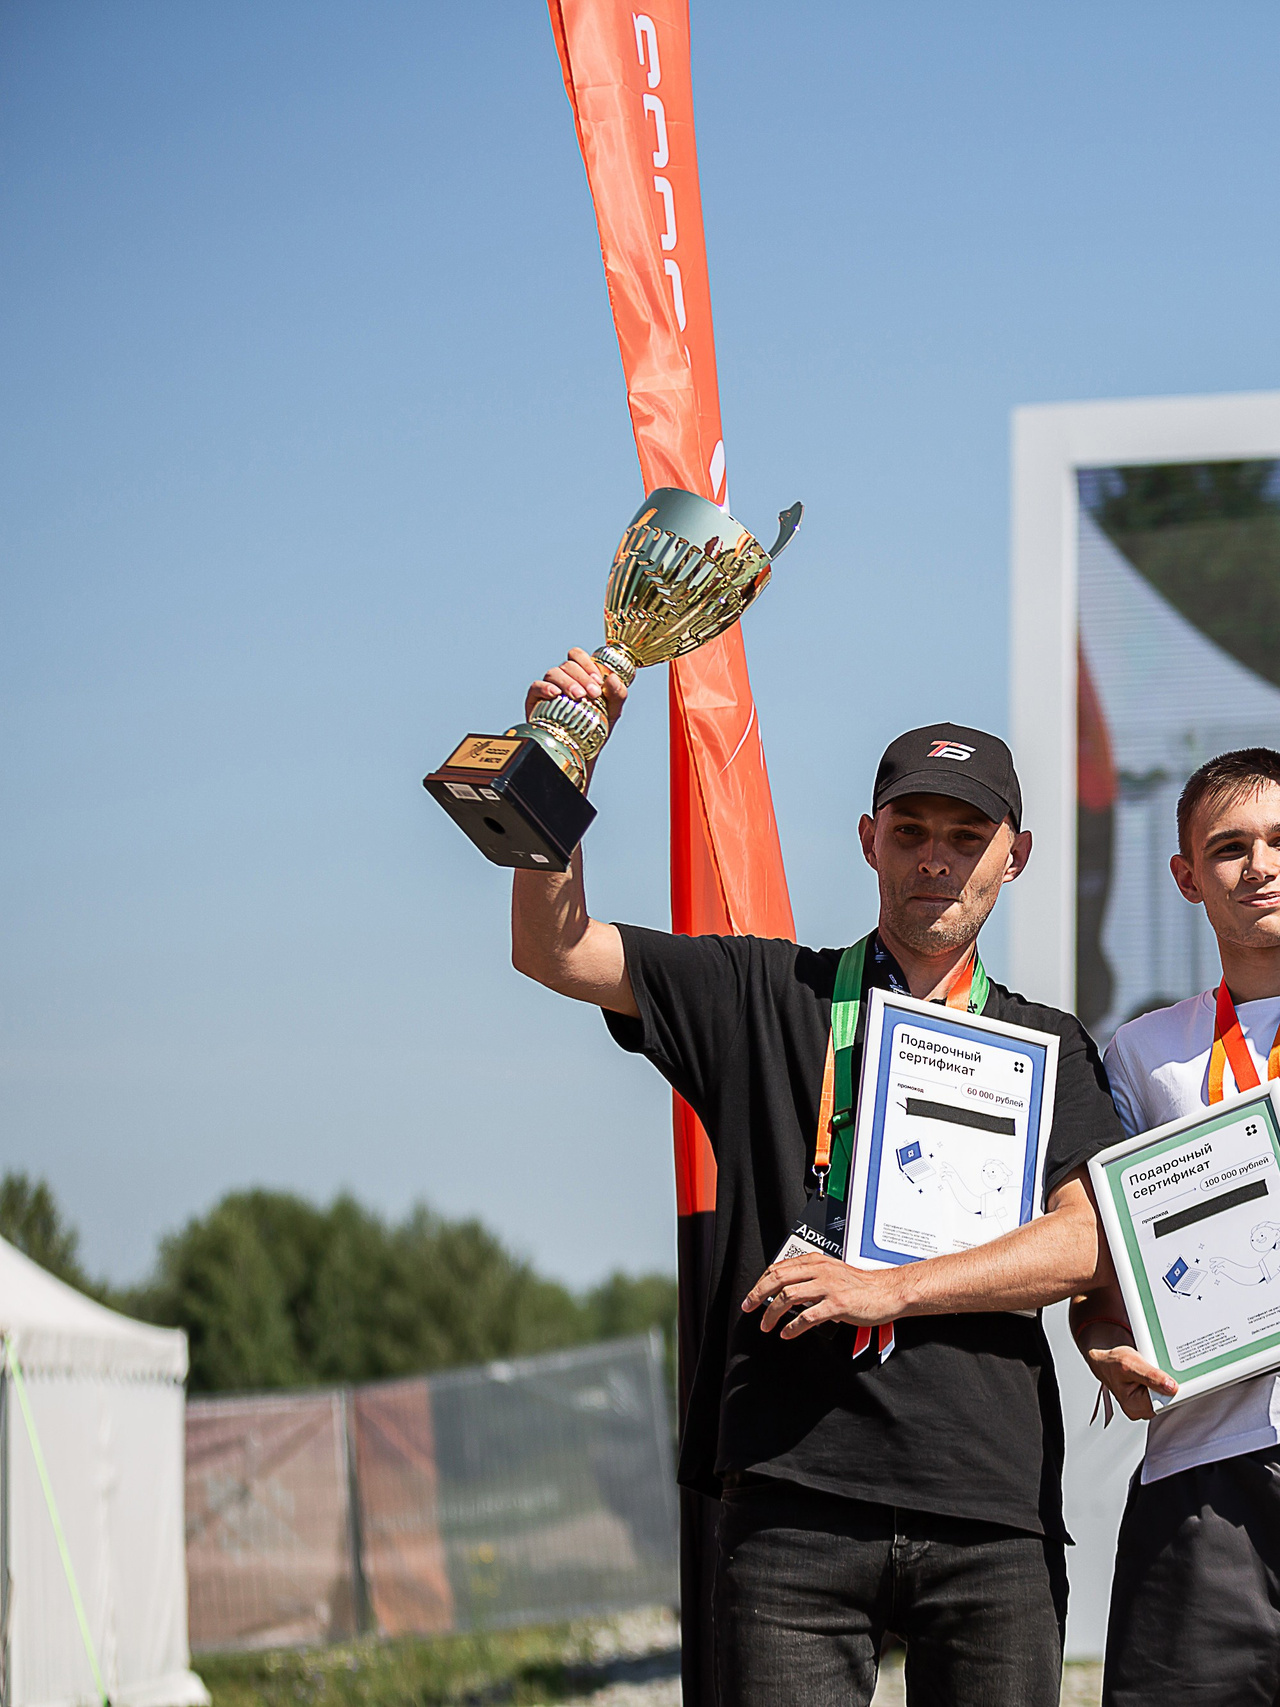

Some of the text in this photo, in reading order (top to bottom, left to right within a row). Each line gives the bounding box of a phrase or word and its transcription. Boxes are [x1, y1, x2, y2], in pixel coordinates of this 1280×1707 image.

[900, 1033, 982, 1063] Подарочный
[899, 1050, 975, 1077] сертификат
[897, 1082, 924, 1094] промокод
[967, 1087, 1024, 1108] 60 000 рублей
[1129, 1143, 1213, 1187] Подарочный
[1204, 1155, 1269, 1188] 100 000 рублей
[1133, 1160, 1211, 1200] сертификат
[1141, 1209, 1169, 1225] промокод
